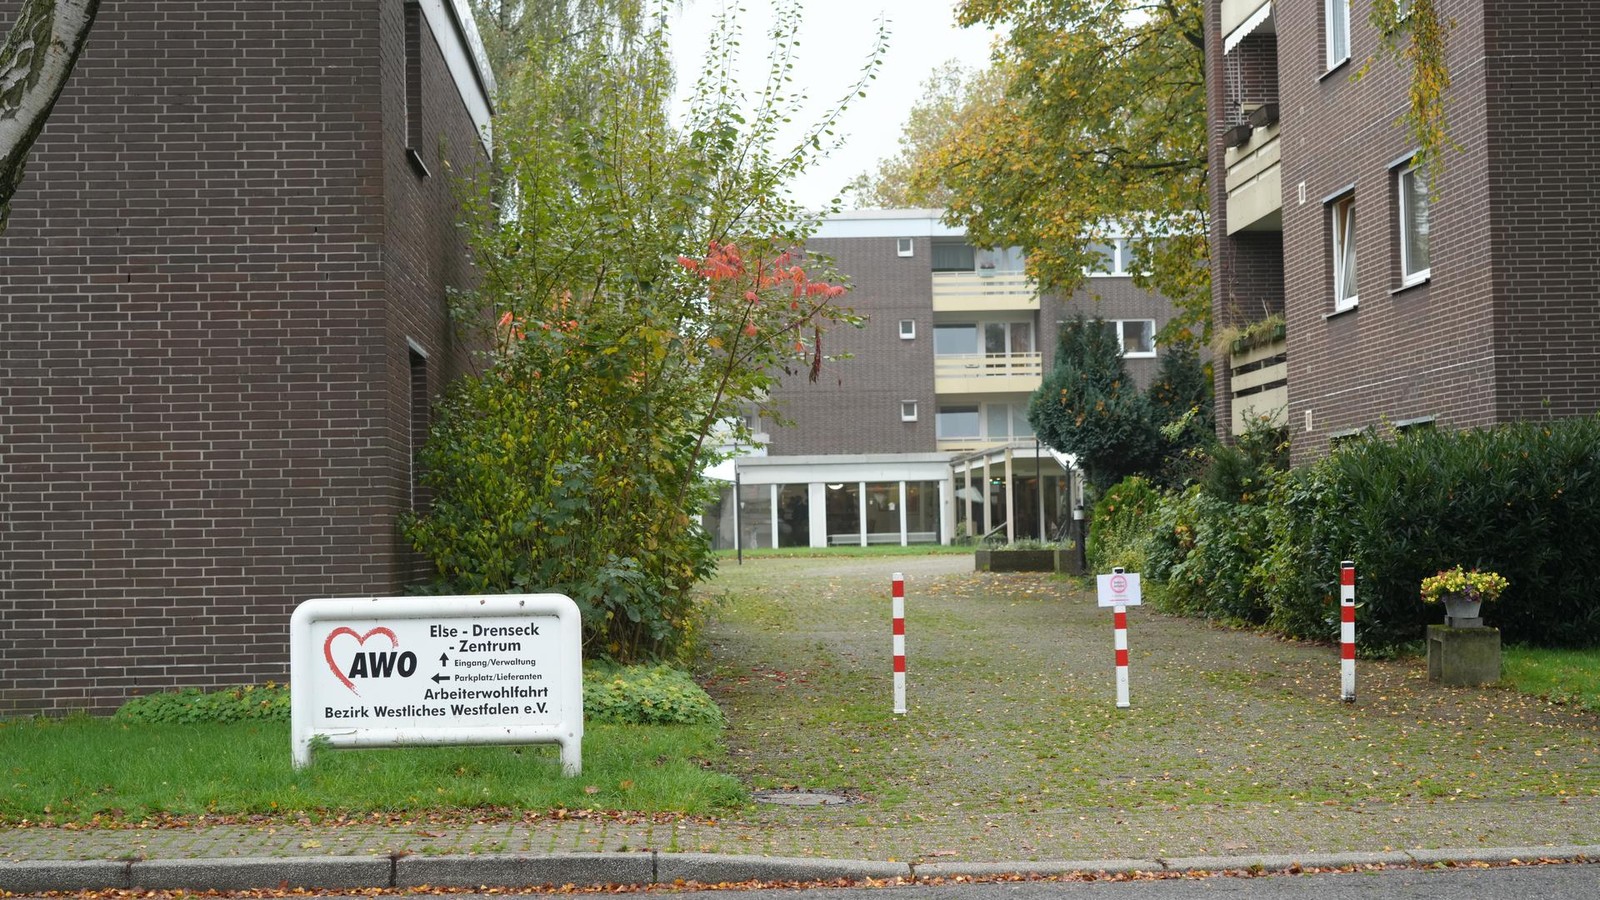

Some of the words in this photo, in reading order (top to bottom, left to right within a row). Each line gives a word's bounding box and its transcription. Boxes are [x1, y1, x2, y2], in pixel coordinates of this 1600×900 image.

[430, 625, 458, 638] Else
[473, 623, 540, 637] Drenseck
[459, 640, 521, 653] Zentrum
[349, 651, 418, 678] AWO
[454, 658, 536, 668] Eingang/Verwaltung
[454, 672, 542, 682] Parkplatz/Lieferanten
[424, 686, 548, 700] Arbeiterwohlfahrt
[325, 706, 369, 718] Bezirk
[374, 705, 446, 717] Westliches
[451, 704, 519, 716] Westfalen
[524, 702, 548, 714] e.V.
